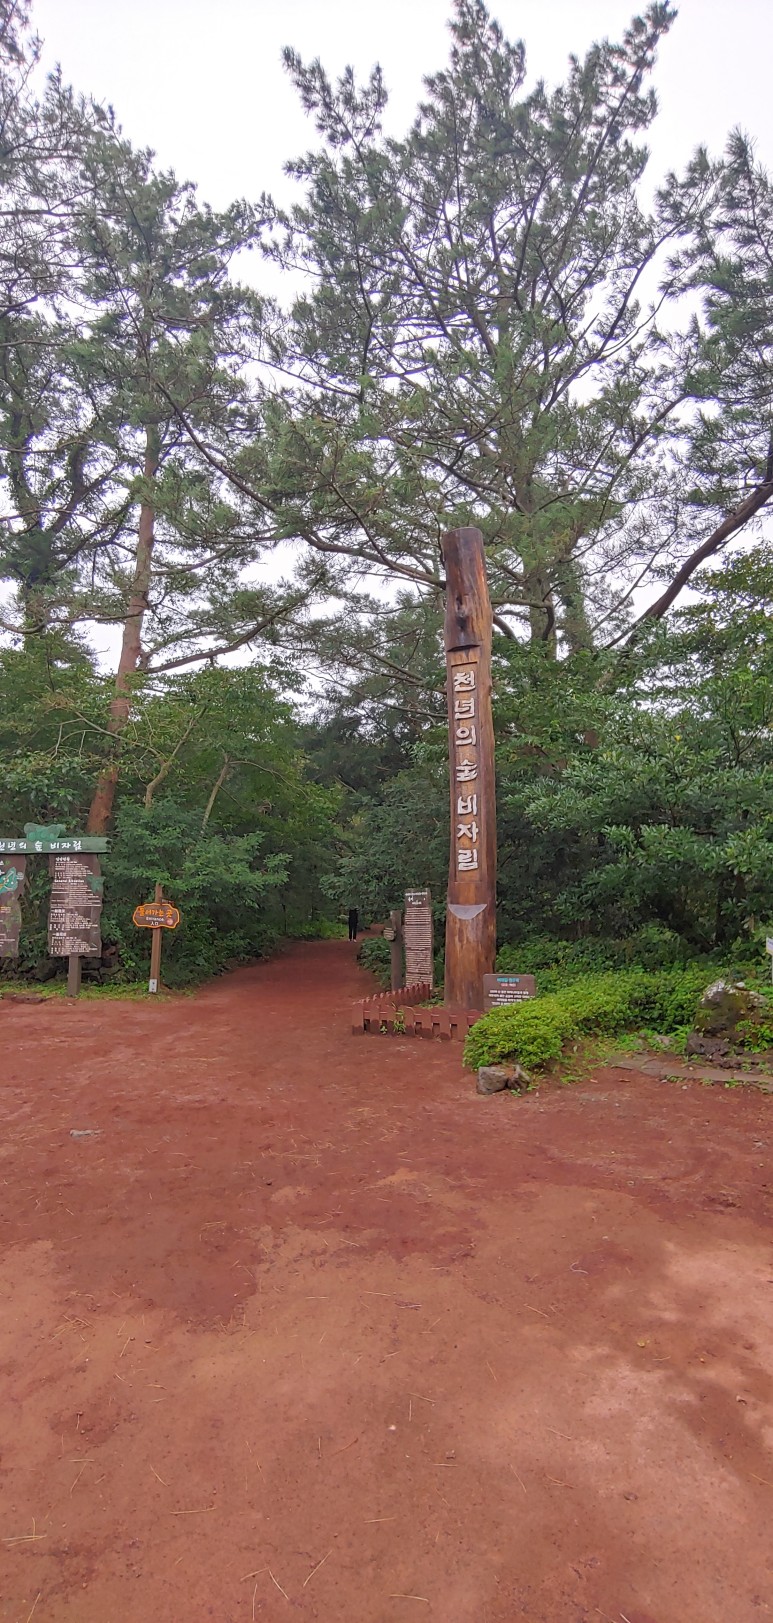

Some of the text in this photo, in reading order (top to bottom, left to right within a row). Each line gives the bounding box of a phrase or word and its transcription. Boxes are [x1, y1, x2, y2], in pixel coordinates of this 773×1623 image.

[453, 670, 479, 871] 천년의 숲 비자림
[35, 840, 43, 852] 숲
[50, 841, 82, 851] 비자림
[139, 906, 164, 917] 들어가는
